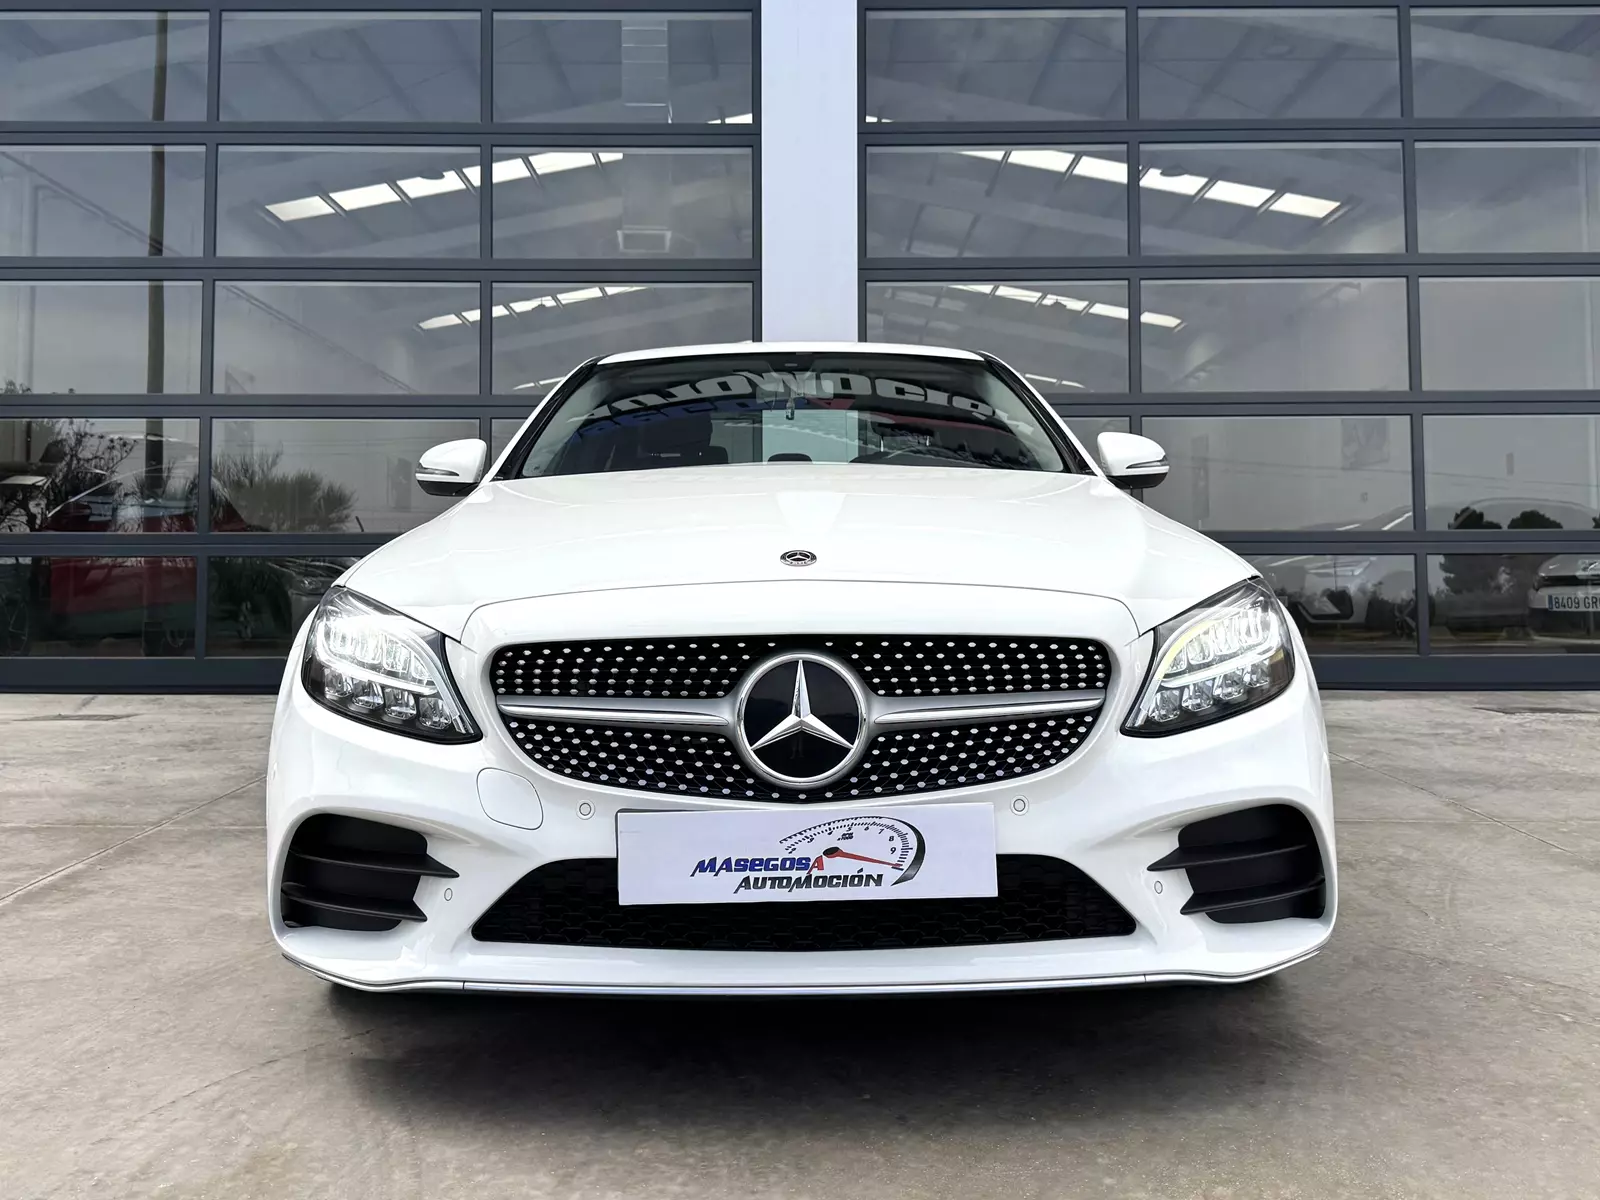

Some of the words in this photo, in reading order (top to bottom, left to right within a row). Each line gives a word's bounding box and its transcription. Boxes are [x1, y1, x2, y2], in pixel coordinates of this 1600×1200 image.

[1553, 596, 1580, 609] 8409
[1583, 596, 1600, 609] GR
[890, 846, 897, 854] 9
[690, 855, 825, 877] MASEGOSA
[733, 867, 884, 894] AUTOMOCIÓN
